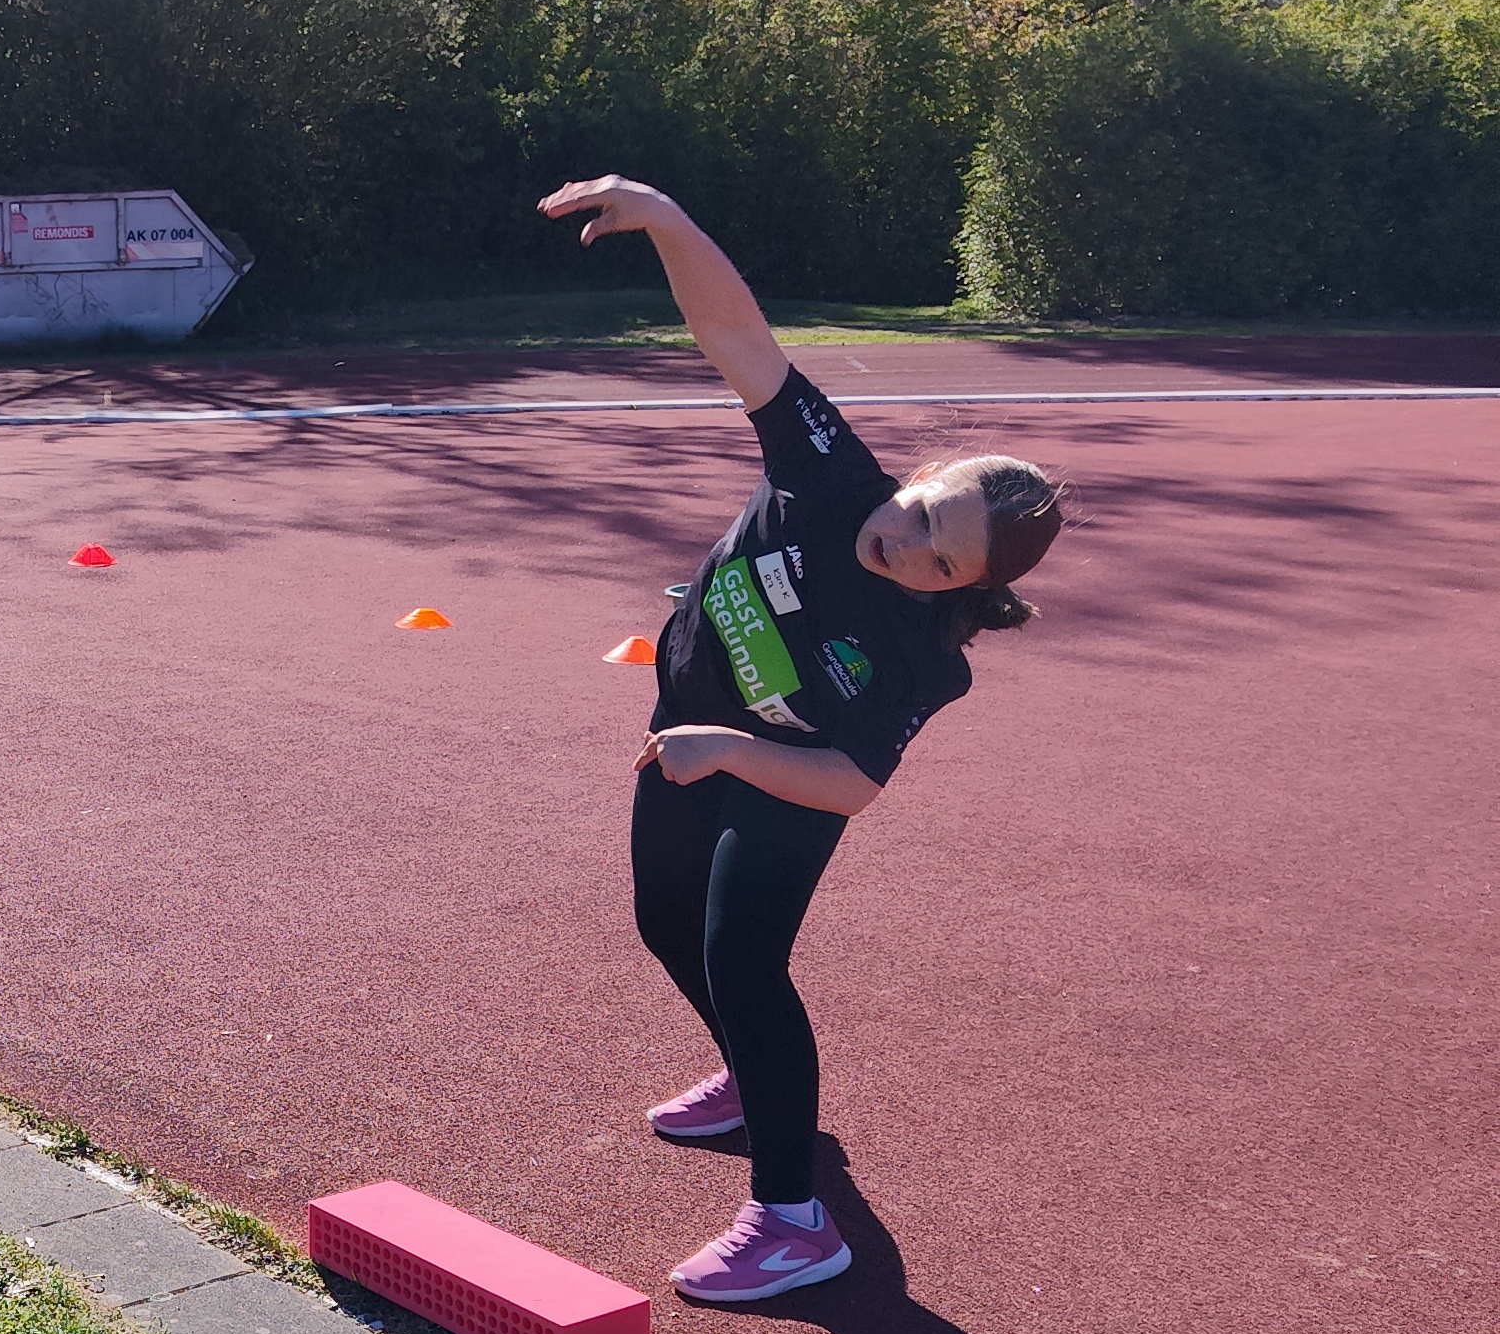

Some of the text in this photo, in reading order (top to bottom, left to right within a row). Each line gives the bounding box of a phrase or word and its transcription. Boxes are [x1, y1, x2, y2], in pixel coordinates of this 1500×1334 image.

[34, 227, 89, 239] REMONDIS
[126, 228, 194, 242] AK 07 004
[795, 397, 832, 447] FLERALARM
[773, 567, 785, 589] Kim
[785, 544, 804, 580] JAKO
[724, 569, 765, 638] Gast
[822, 642, 858, 696] Grundschule
